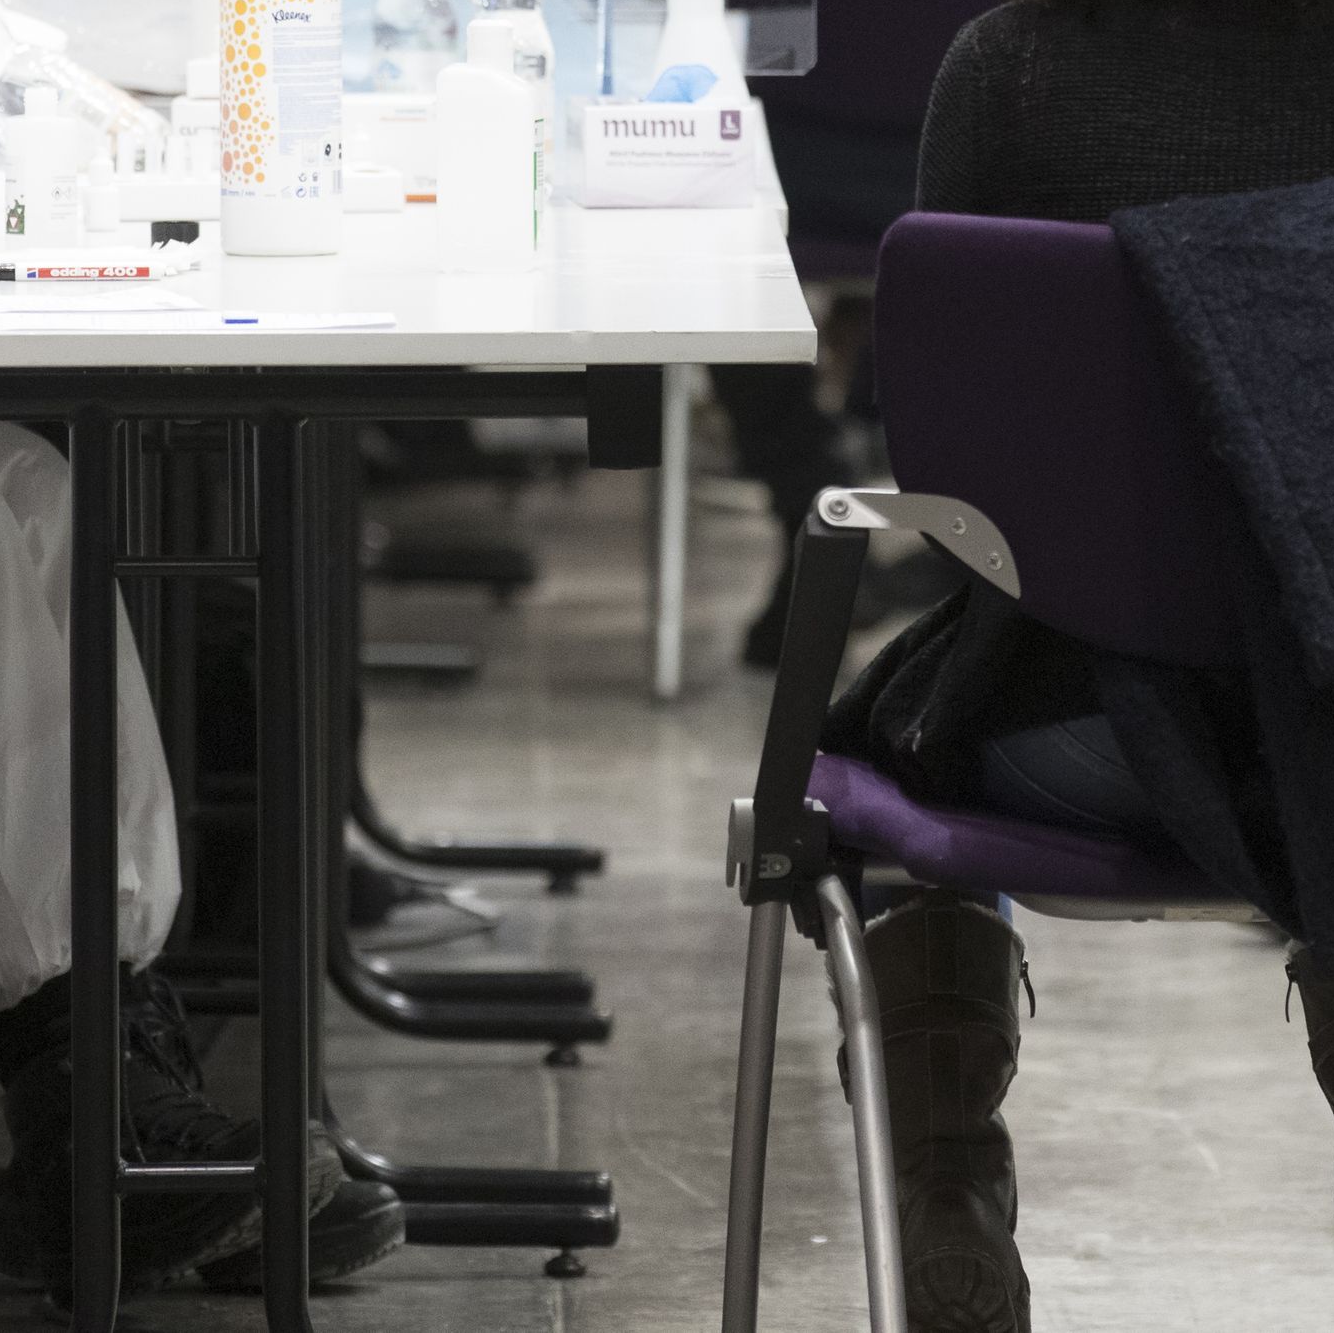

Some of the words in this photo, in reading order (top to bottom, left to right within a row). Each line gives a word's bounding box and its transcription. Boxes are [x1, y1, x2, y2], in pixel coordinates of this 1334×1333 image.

[603, 119, 695, 137] mumu
[50, 268, 100, 278] edding
[103, 268, 137, 277] 400
